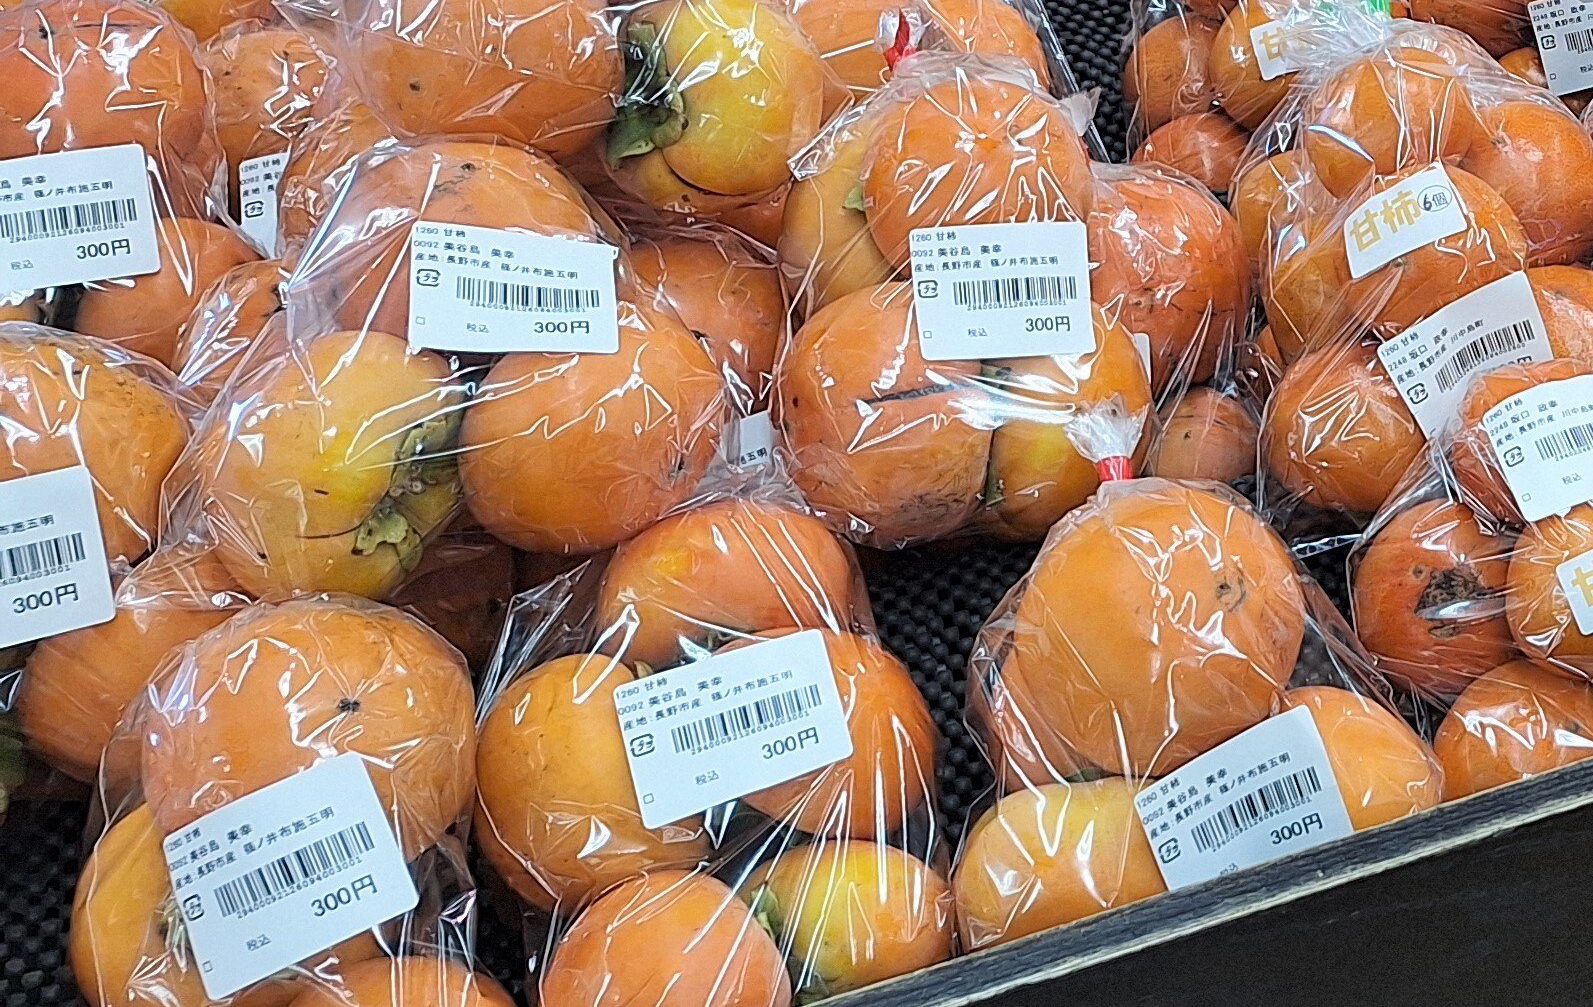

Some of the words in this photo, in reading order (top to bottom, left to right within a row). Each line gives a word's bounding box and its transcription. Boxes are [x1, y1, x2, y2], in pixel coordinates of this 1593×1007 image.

[1259, 26, 1286, 62] 甘
[1350, 190, 1421, 252] 甘柿
[444, 229, 465, 238] 甘柿
[912, 234, 931, 242] 1260
[936, 232, 956, 241] 甘柿
[77, 239, 130, 259] 300円
[912, 249, 933, 257] 0092
[11, 260, 33, 270] 税込
[466, 323, 489, 333] 税込
[534, 321, 589, 334] 300円
[968, 328, 987, 336] 税込
[1025, 316, 1070, 332] 300円
[1382, 345, 1398, 357] 1260
[1401, 332, 1419, 346] 甘柿
[1388, 357, 1407, 371] 2248
[1562, 473, 1582, 485] 税込
[13, 583, 78, 613] 300円
[616, 687, 639, 699] 1260
[645, 678, 667, 691] 甘柿
[618, 702, 643, 715] 0092
[762, 727, 820, 759] 300円
[696, 771, 719, 785] 税込
[1160, 778, 1180, 794] 甘柿
[1270, 813, 1323, 845] 300円
[311, 875, 377, 917] 300円
[247, 934, 271, 951] 税込
